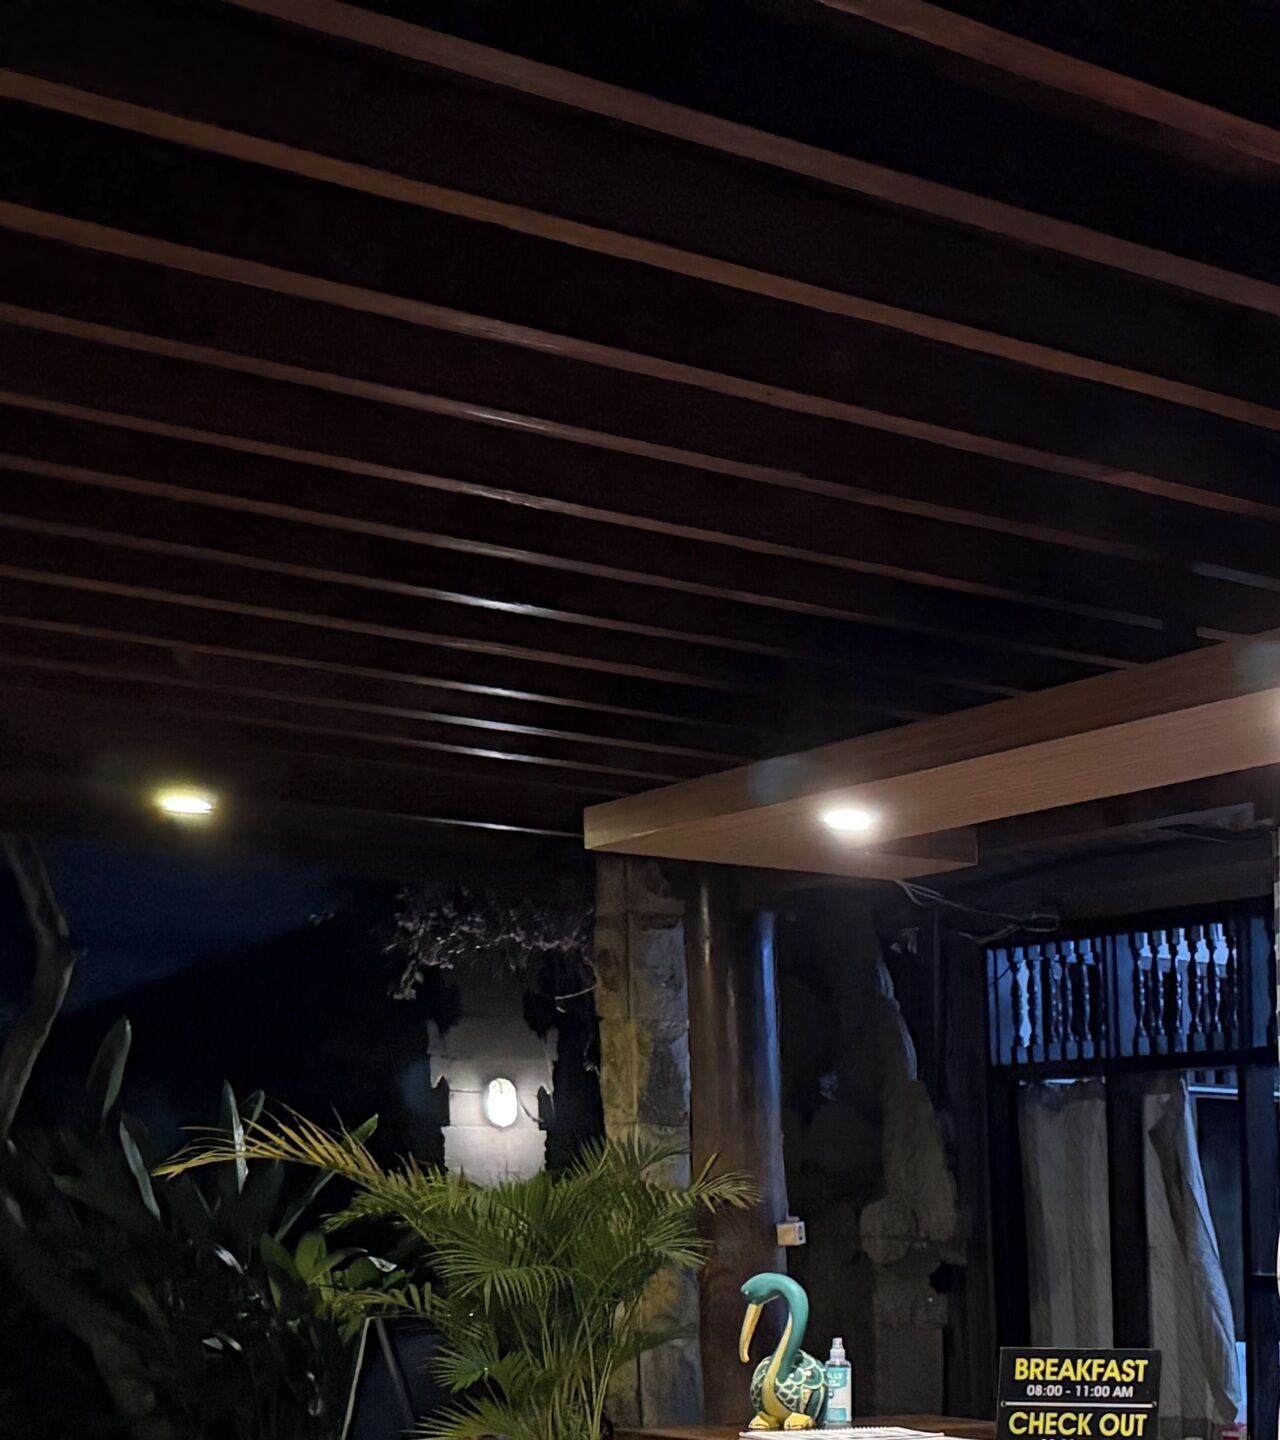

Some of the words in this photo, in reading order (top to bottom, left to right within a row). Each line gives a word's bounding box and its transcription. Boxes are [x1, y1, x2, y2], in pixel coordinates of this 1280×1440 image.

[1014, 1358, 1149, 1382] BREAKFAST
[1026, 1384, 1063, 1397] 08:00
[1075, 1385, 1110, 1398] 11:00
[1112, 1386, 1134, 1398] AM
[1008, 1411, 1093, 1435] CHECK
[1100, 1413, 1148, 1437] OUT
